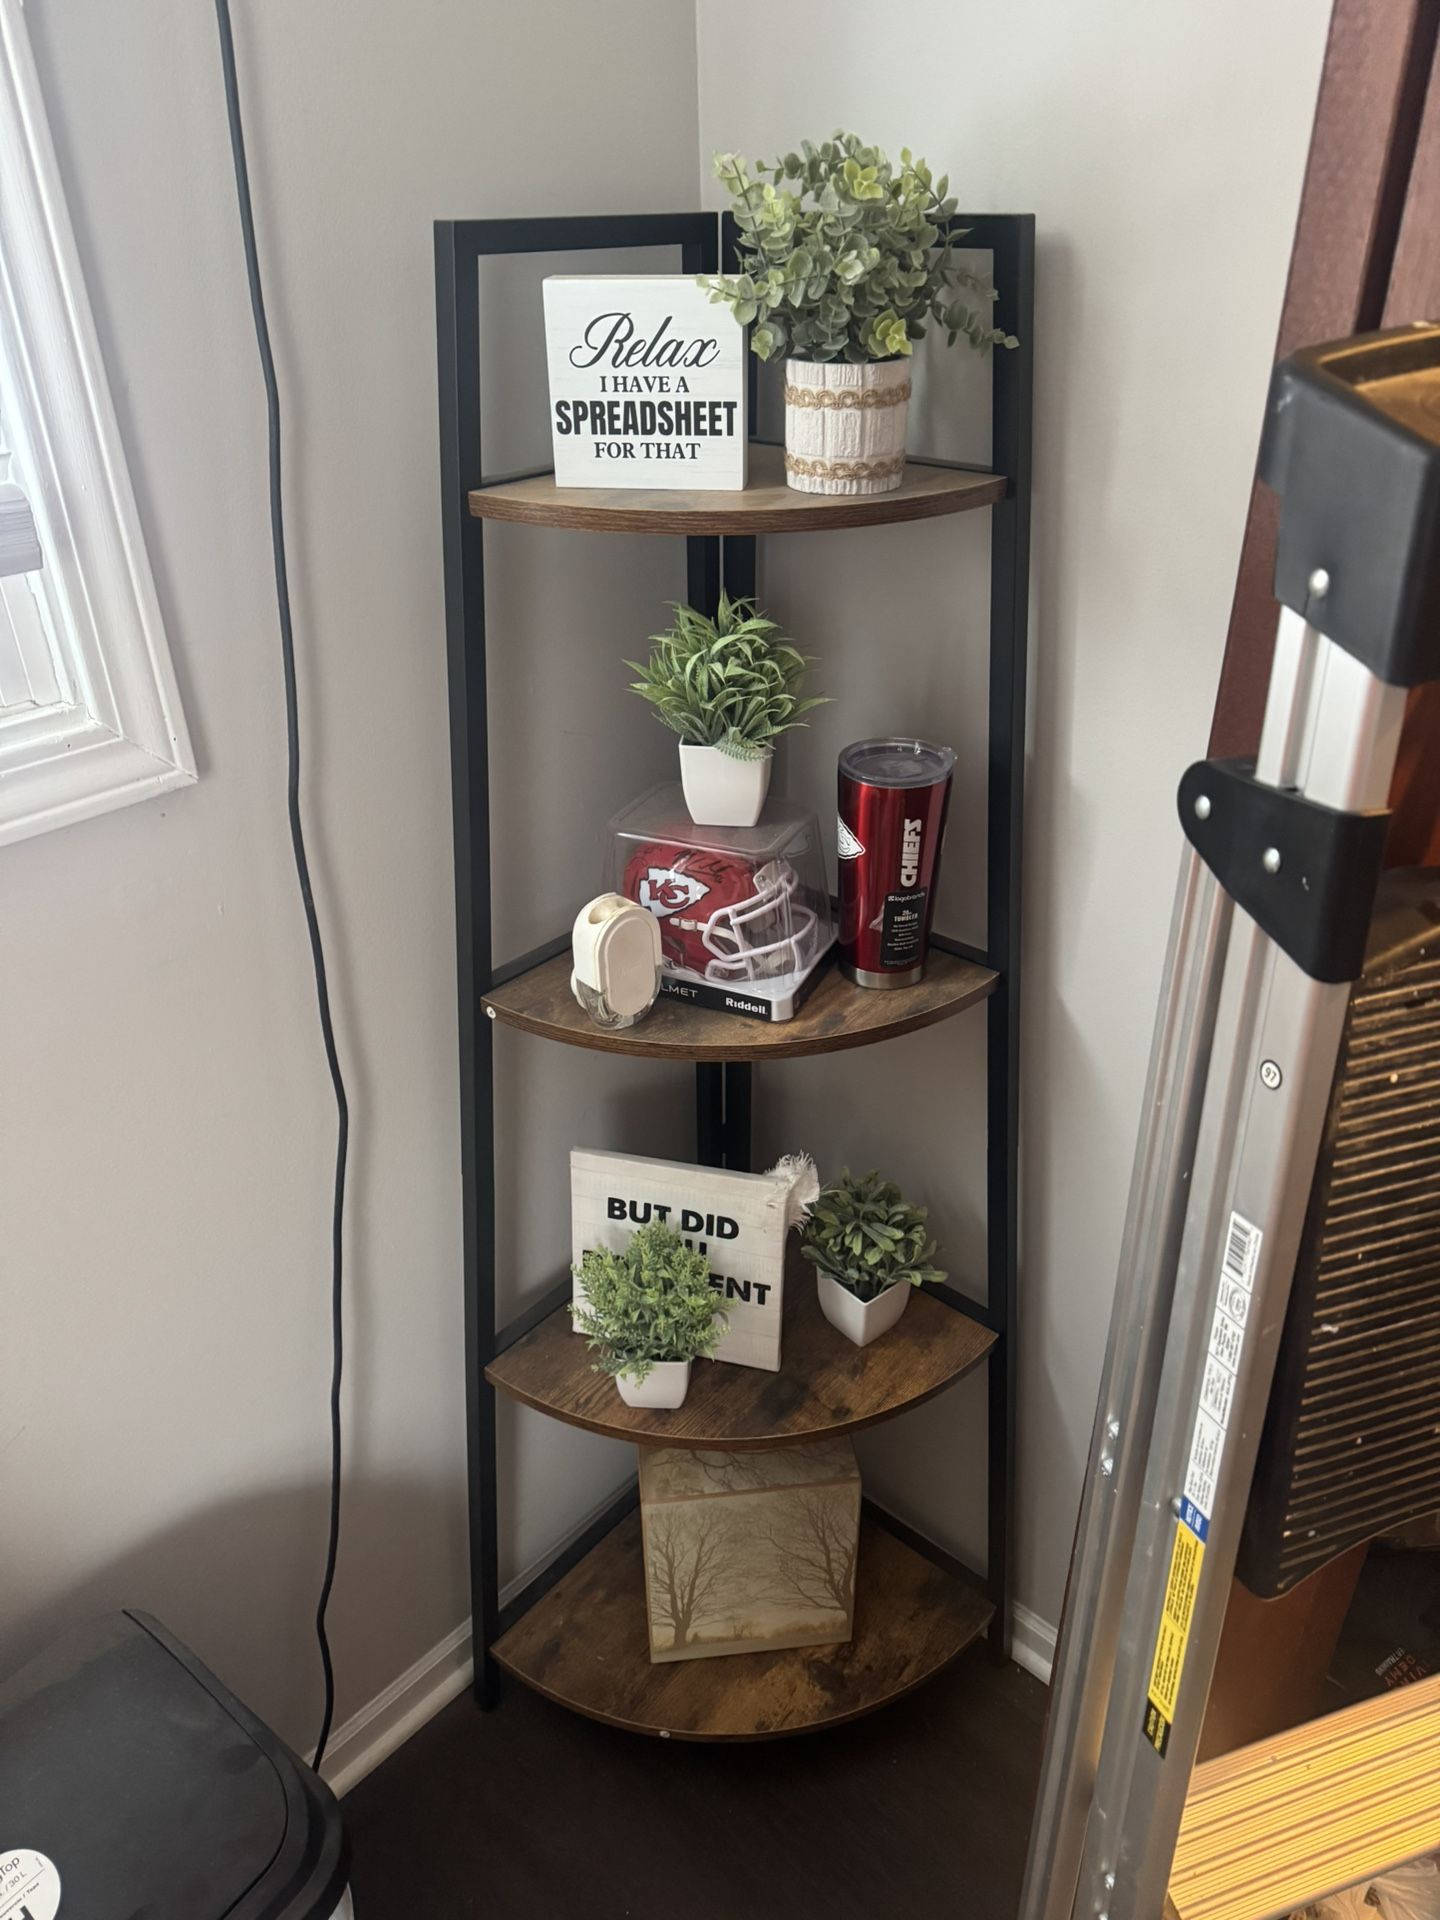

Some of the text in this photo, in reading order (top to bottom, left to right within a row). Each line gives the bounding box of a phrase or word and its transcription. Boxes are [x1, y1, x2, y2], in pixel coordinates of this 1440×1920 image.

[569, 312, 721, 369] Relax
[600, 376, 690, 393] I HAVE A
[555, 400, 737, 437] SPREADSHEET
[594, 442, 701, 460] FOR THAT
[900, 818, 922, 888] CHIEFS
[648, 879, 690, 909] KC
[661, 984, 767, 1015] LMET Riddell
[607, 1196, 739, 1240] BUT DID
[0, 1857, 20, 1882] Top
